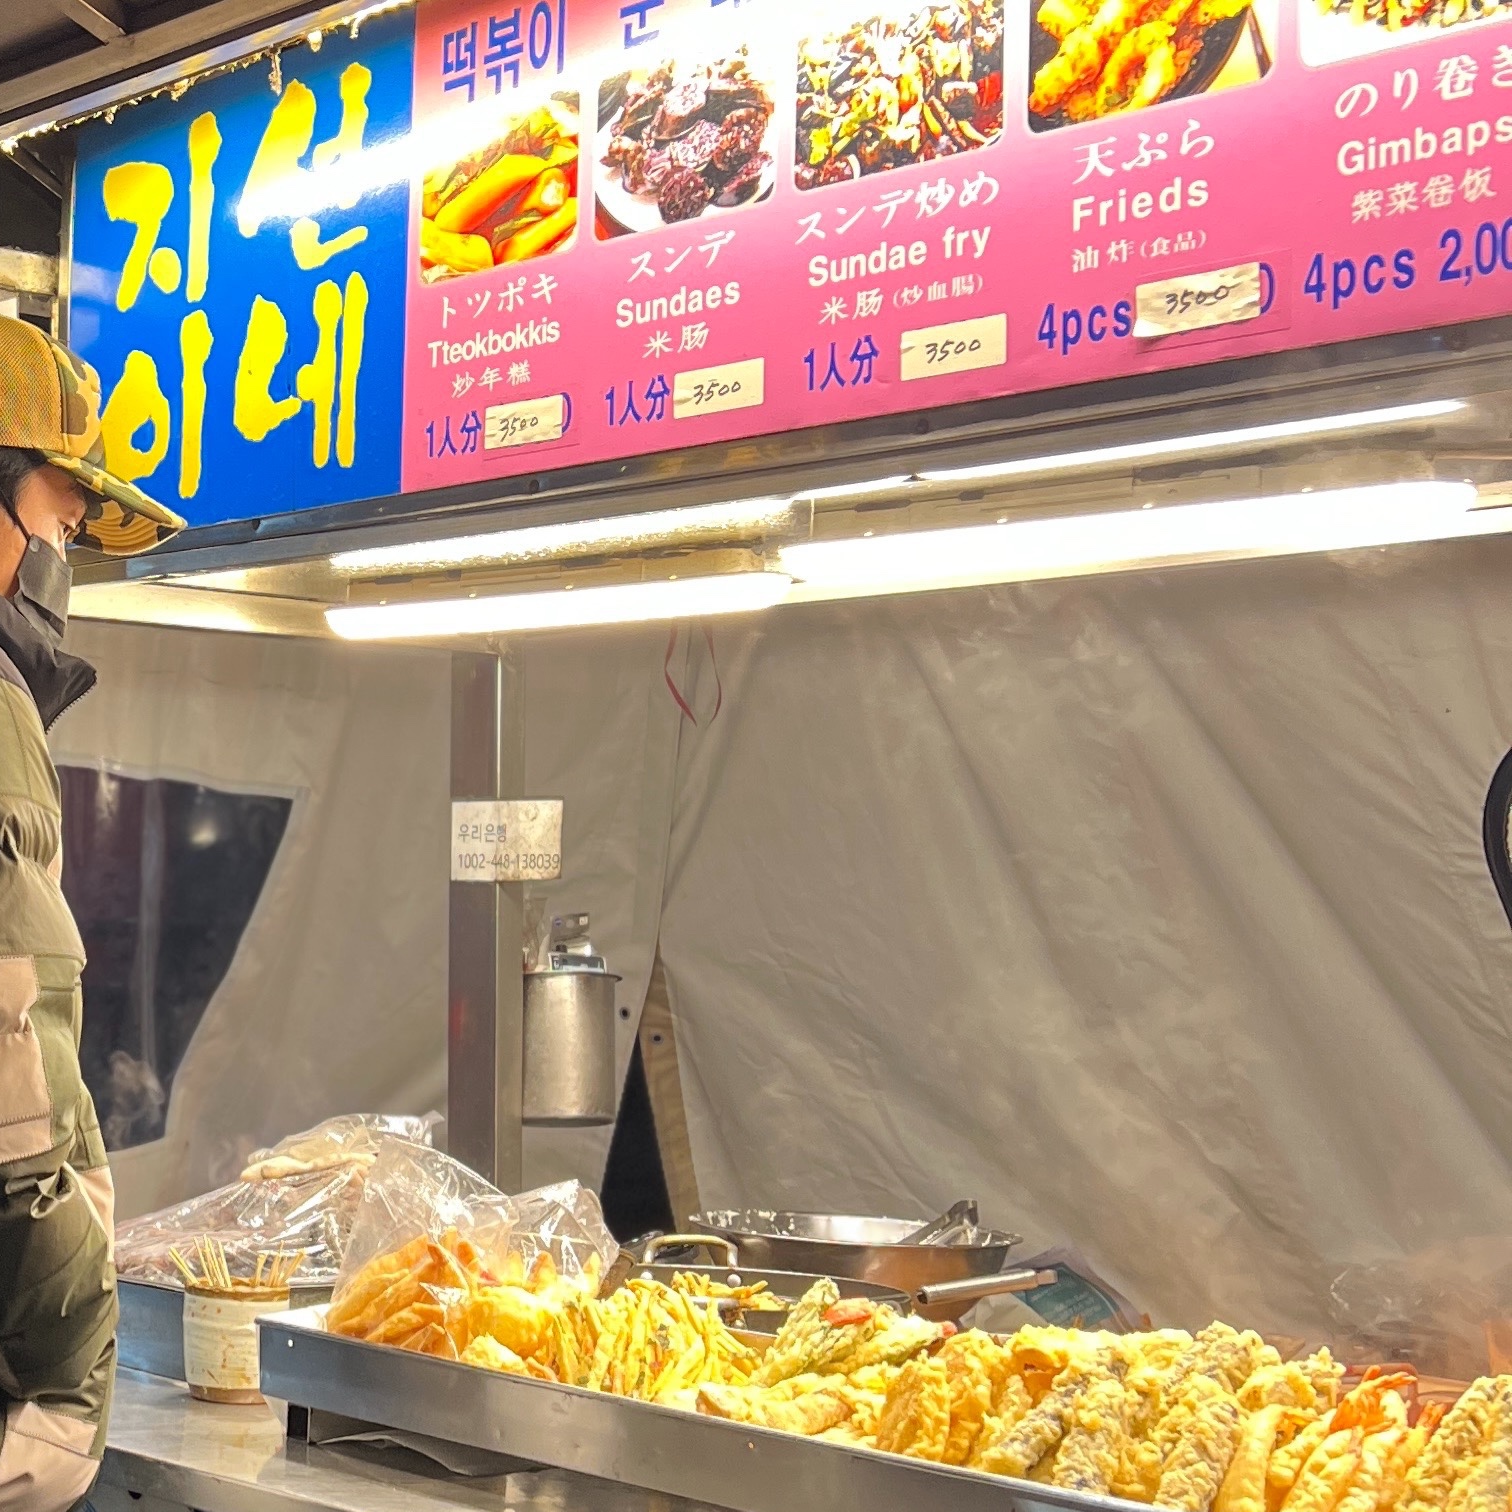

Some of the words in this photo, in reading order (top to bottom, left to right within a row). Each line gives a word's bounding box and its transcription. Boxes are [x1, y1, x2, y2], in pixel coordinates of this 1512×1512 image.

[442, 0, 566, 103] 떡볶이
[1072, 118, 1215, 185] 天ぷら
[1337, 115, 1512, 176] Gimbaps
[795, 171, 1000, 245] スンデ炒め
[1072, 176, 1209, 232] Frieds
[627, 229, 737, 283] スンデ
[808, 241, 928, 287] Sundae
[942, 226, 992, 259] fry
[1304, 248, 1416, 310] 4pcs
[616, 281, 741, 328] Sundaes
[1165, 284, 1235, 315] 3500
[427, 316, 561, 369] Tteokbokkis
[642, 321, 710, 359] 米肠
[925, 338, 982, 365] 3500
[1038, 299, 1133, 356] 4pcs
[100, 271, 369, 499] 이네
[451, 359, 532, 399] 炒年糕
[803, 334, 880, 393] 1人分
[605, 374, 671, 427] 1人分
[693, 379, 742, 406] 3500
[425, 409, 483, 459] 1人分
[499, 416, 539, 443] 3500
[457, 823, 507, 844] 우리은행
[457, 853, 561, 870] 1002-448-138039
